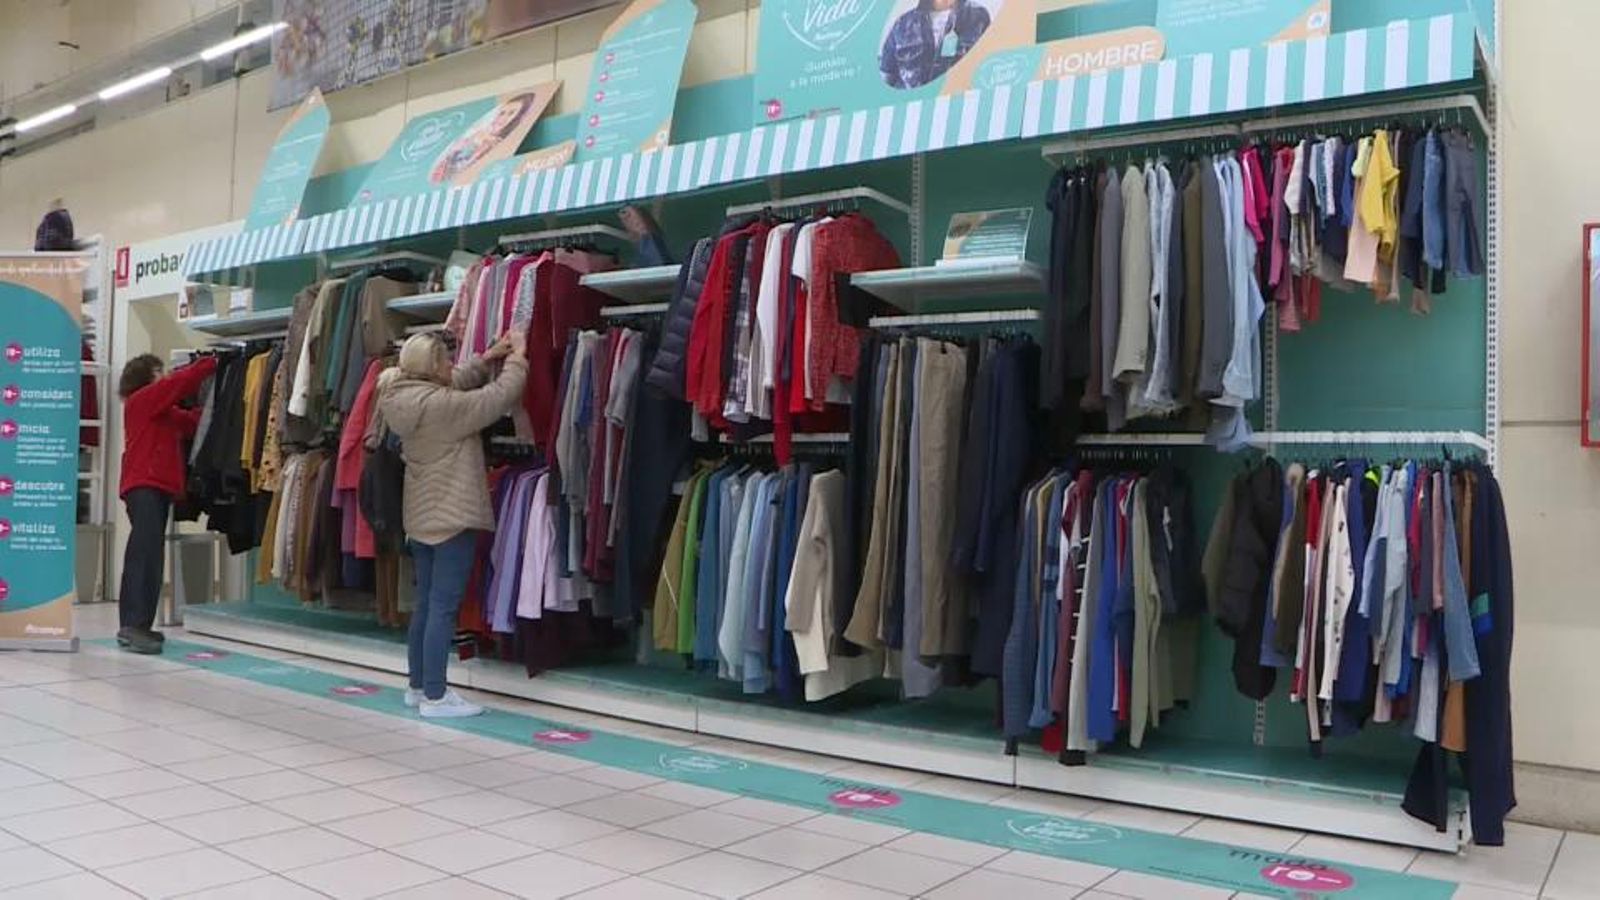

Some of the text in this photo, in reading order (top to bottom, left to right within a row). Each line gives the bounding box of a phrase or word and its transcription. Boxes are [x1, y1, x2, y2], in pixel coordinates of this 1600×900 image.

[1046, 40, 1158, 76] HOMBRE
[24, 347, 61, 358] utiliza
[1229, 849, 1328, 870] moda
